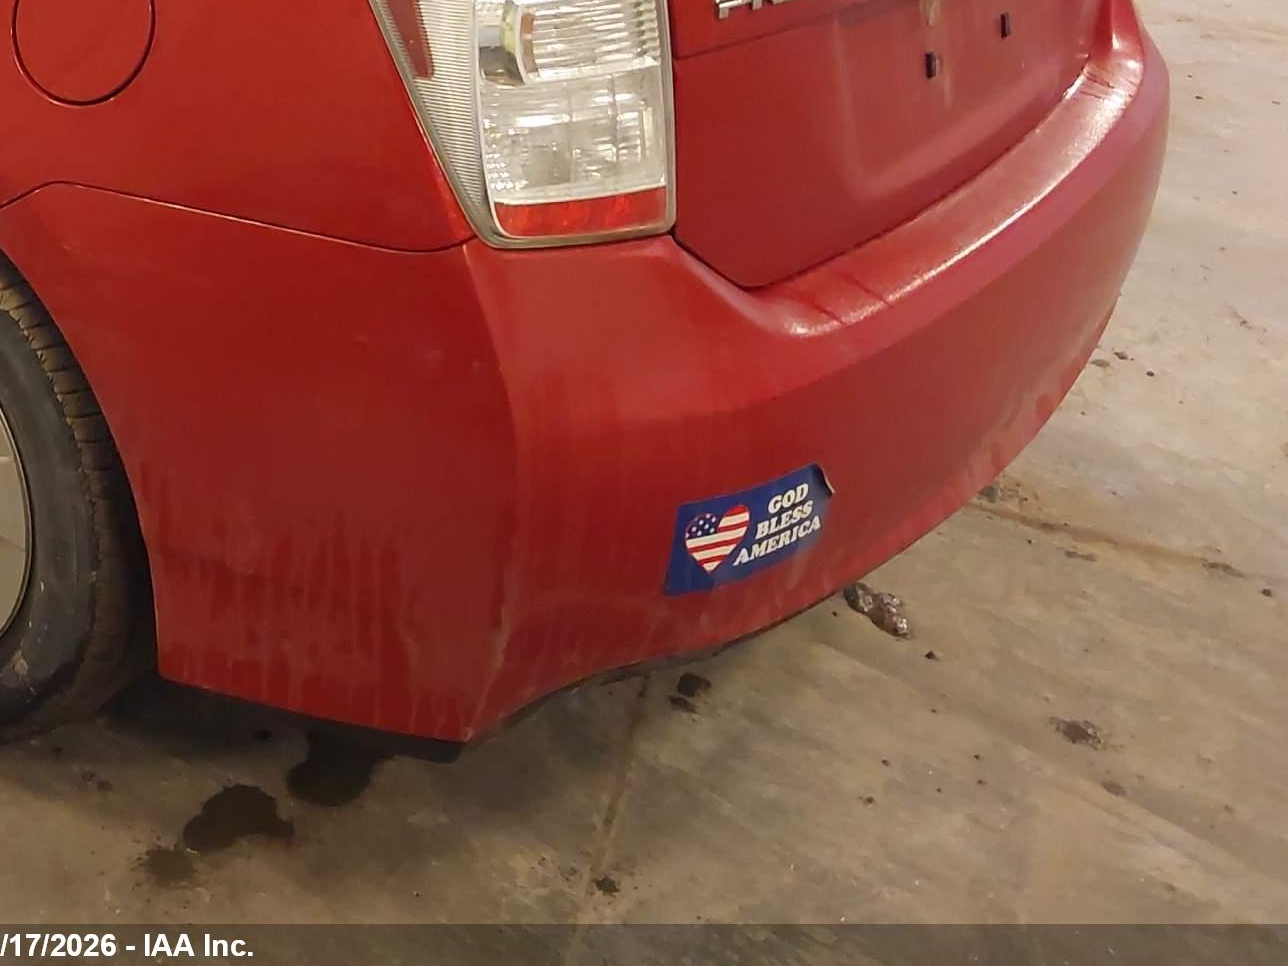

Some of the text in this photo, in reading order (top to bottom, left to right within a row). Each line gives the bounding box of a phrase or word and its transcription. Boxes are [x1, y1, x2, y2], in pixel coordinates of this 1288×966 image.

[767, 483, 809, 514] GOD
[732, 514, 821, 566] AMERICA
[754, 499, 814, 540] BLESS
